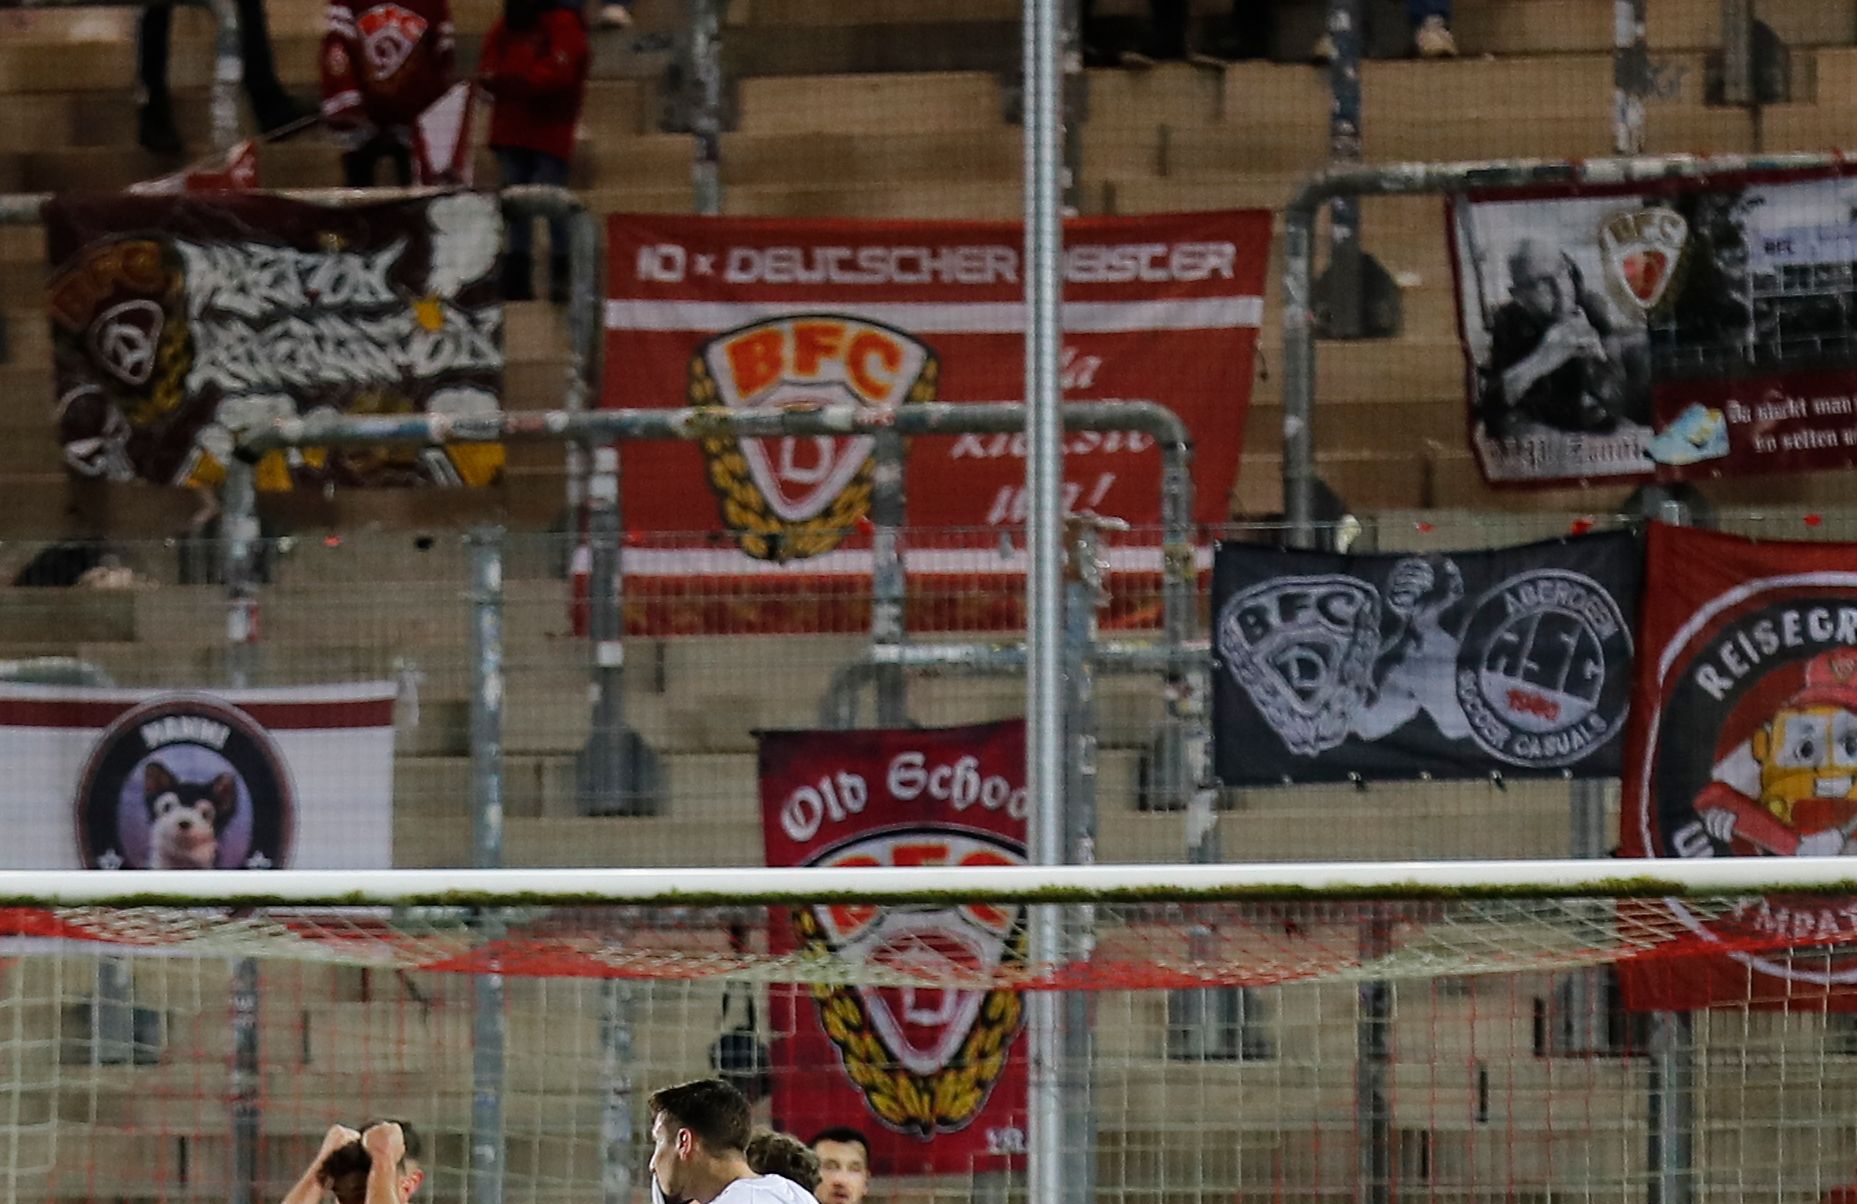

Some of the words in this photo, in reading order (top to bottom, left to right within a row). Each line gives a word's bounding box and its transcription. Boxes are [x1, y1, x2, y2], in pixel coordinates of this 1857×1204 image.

[724, 246, 1017, 283] DEUTSCHER
[1061, 243, 1236, 283] EISTER
[726, 322, 902, 400] BFC
[1238, 591, 1356, 646] BFC
[781, 771, 868, 843] Old
[886, 751, 1029, 821] Schoo
